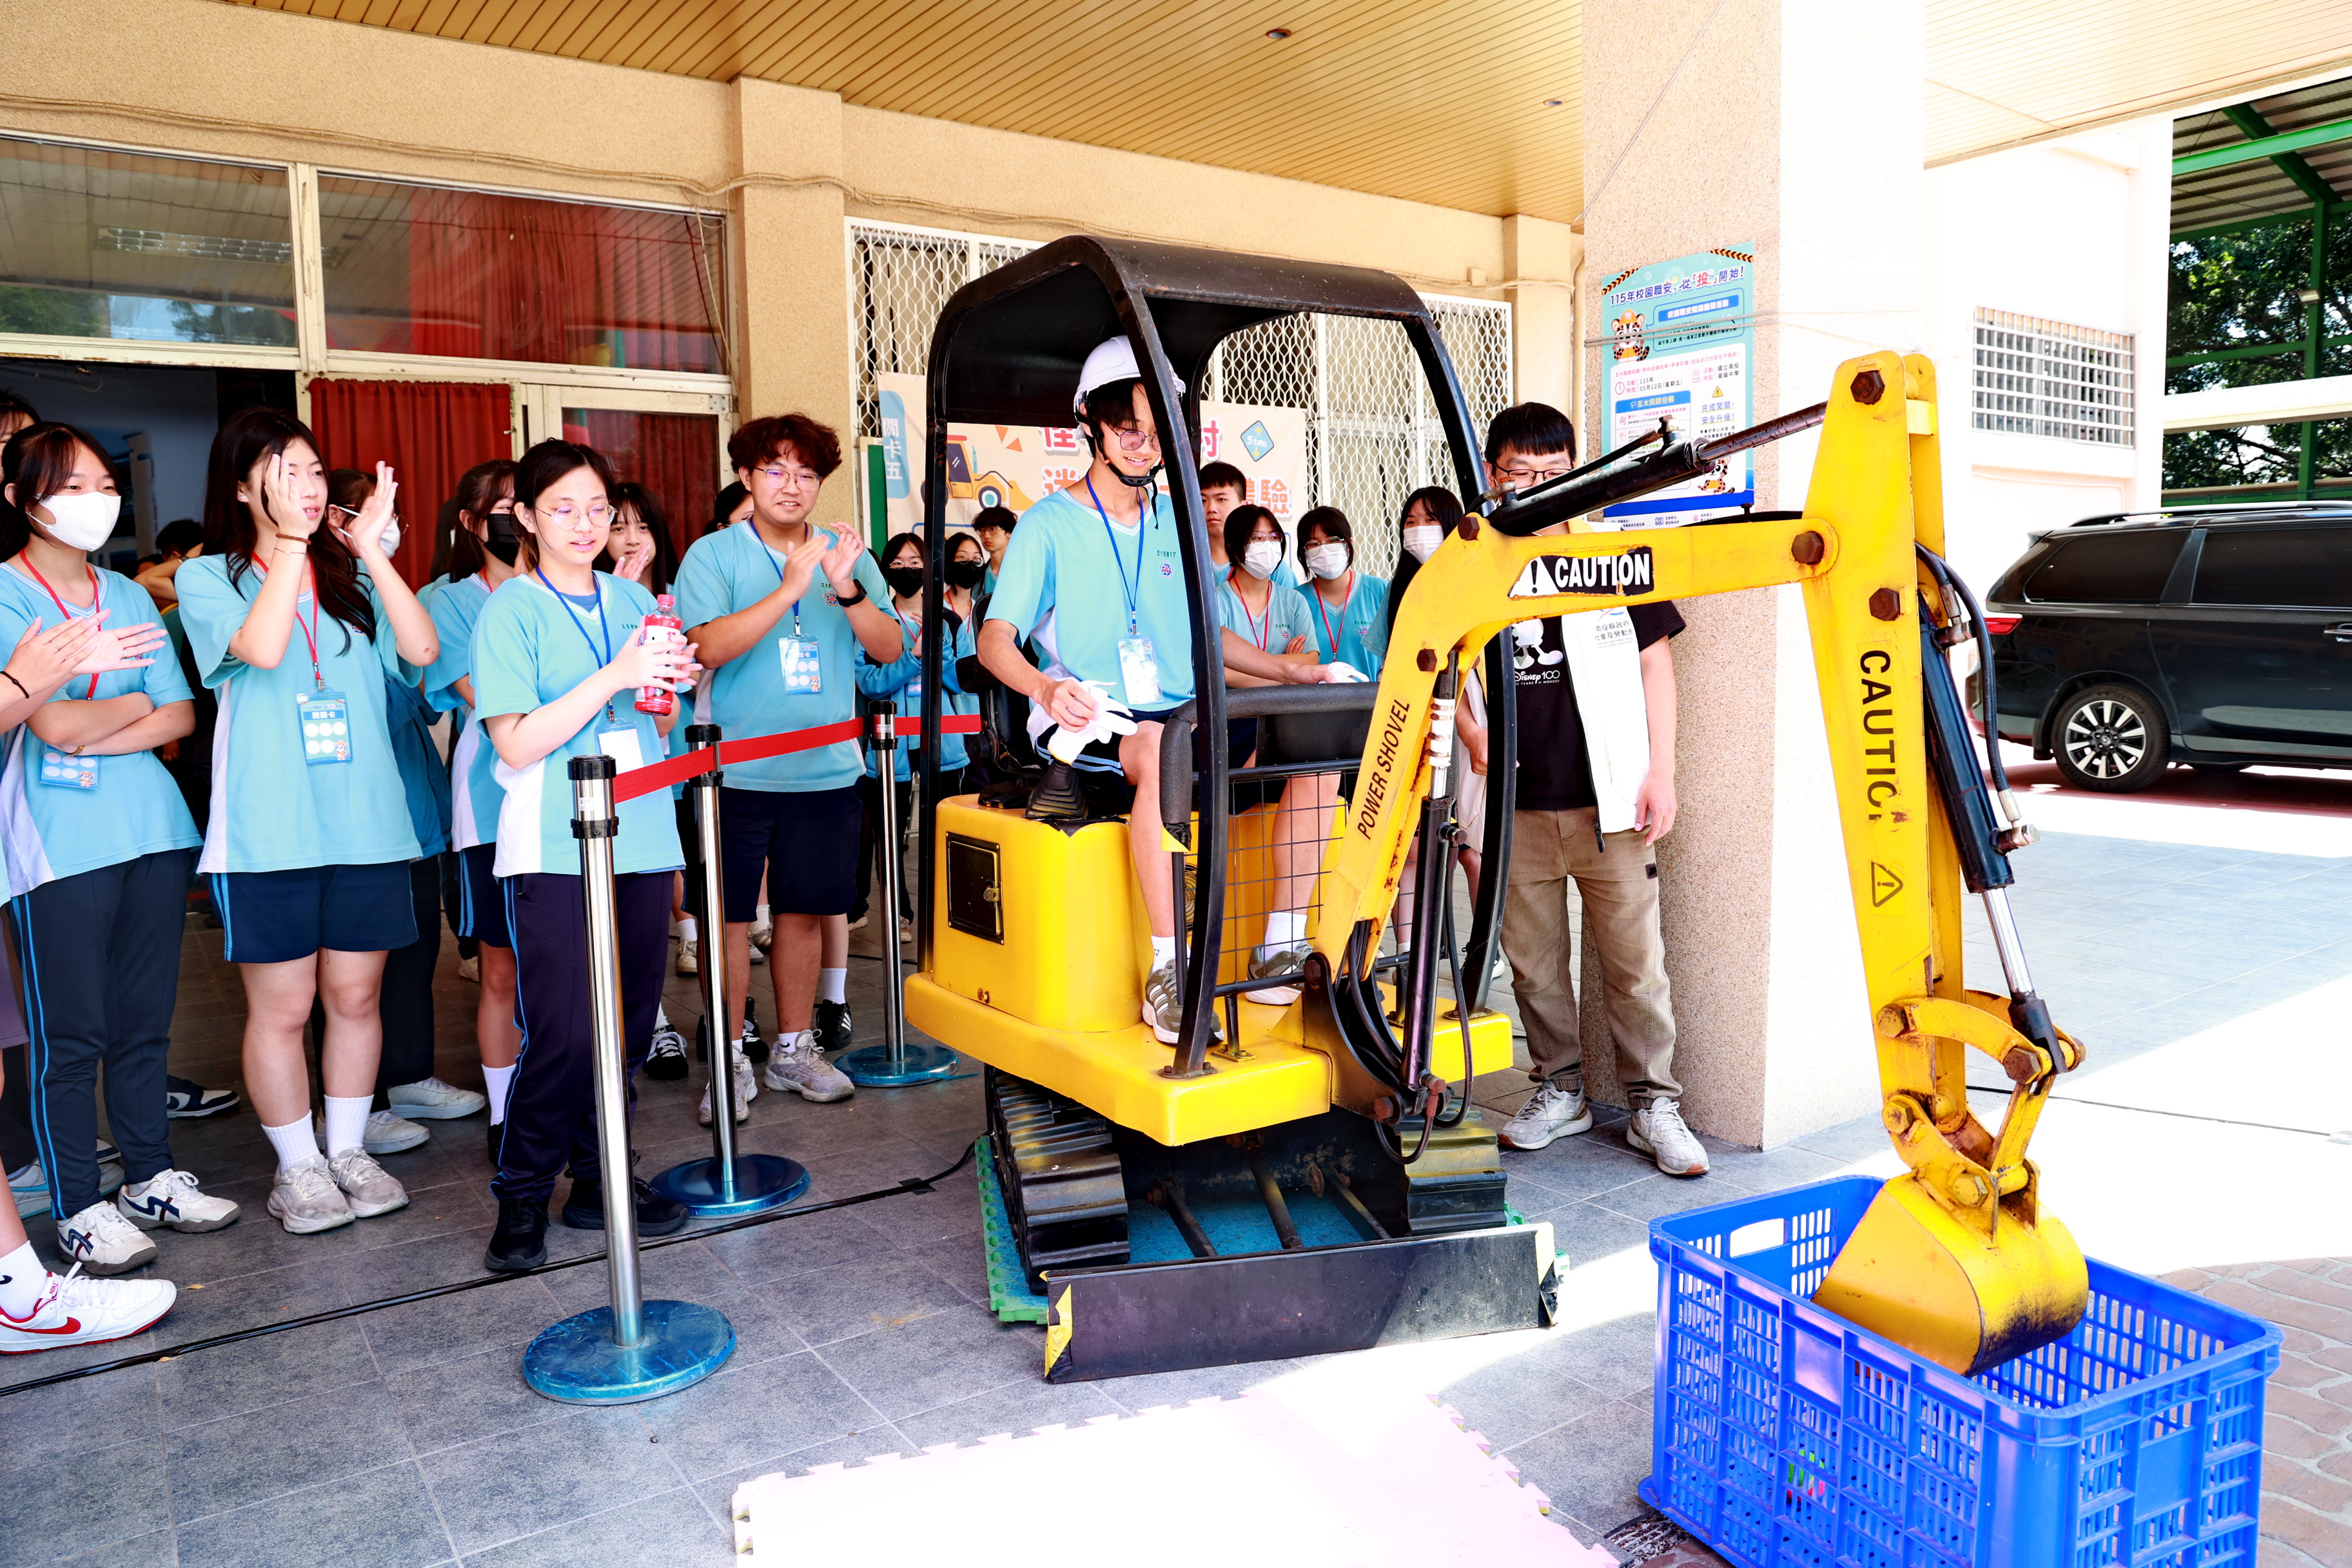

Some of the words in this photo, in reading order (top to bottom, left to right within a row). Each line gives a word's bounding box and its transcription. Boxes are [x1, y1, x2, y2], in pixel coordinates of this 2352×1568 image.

[1718, 362, 1739, 371] 國立南投
[1718, 370, 1739, 378] 高級中學
[882, 416, 903, 480] 關卡五
[1554, 553, 1650, 588] CAUTION
[1595, 620, 1629, 632] 南投縣政府
[1594, 628, 1633, 641] 社會及勞動局
[1542, 670, 1560, 680] 100
[1859, 650, 1897, 820] CAUTIO
[1357, 772, 1387, 841] POWER
[1377, 699, 1410, 773] SHOVEL
